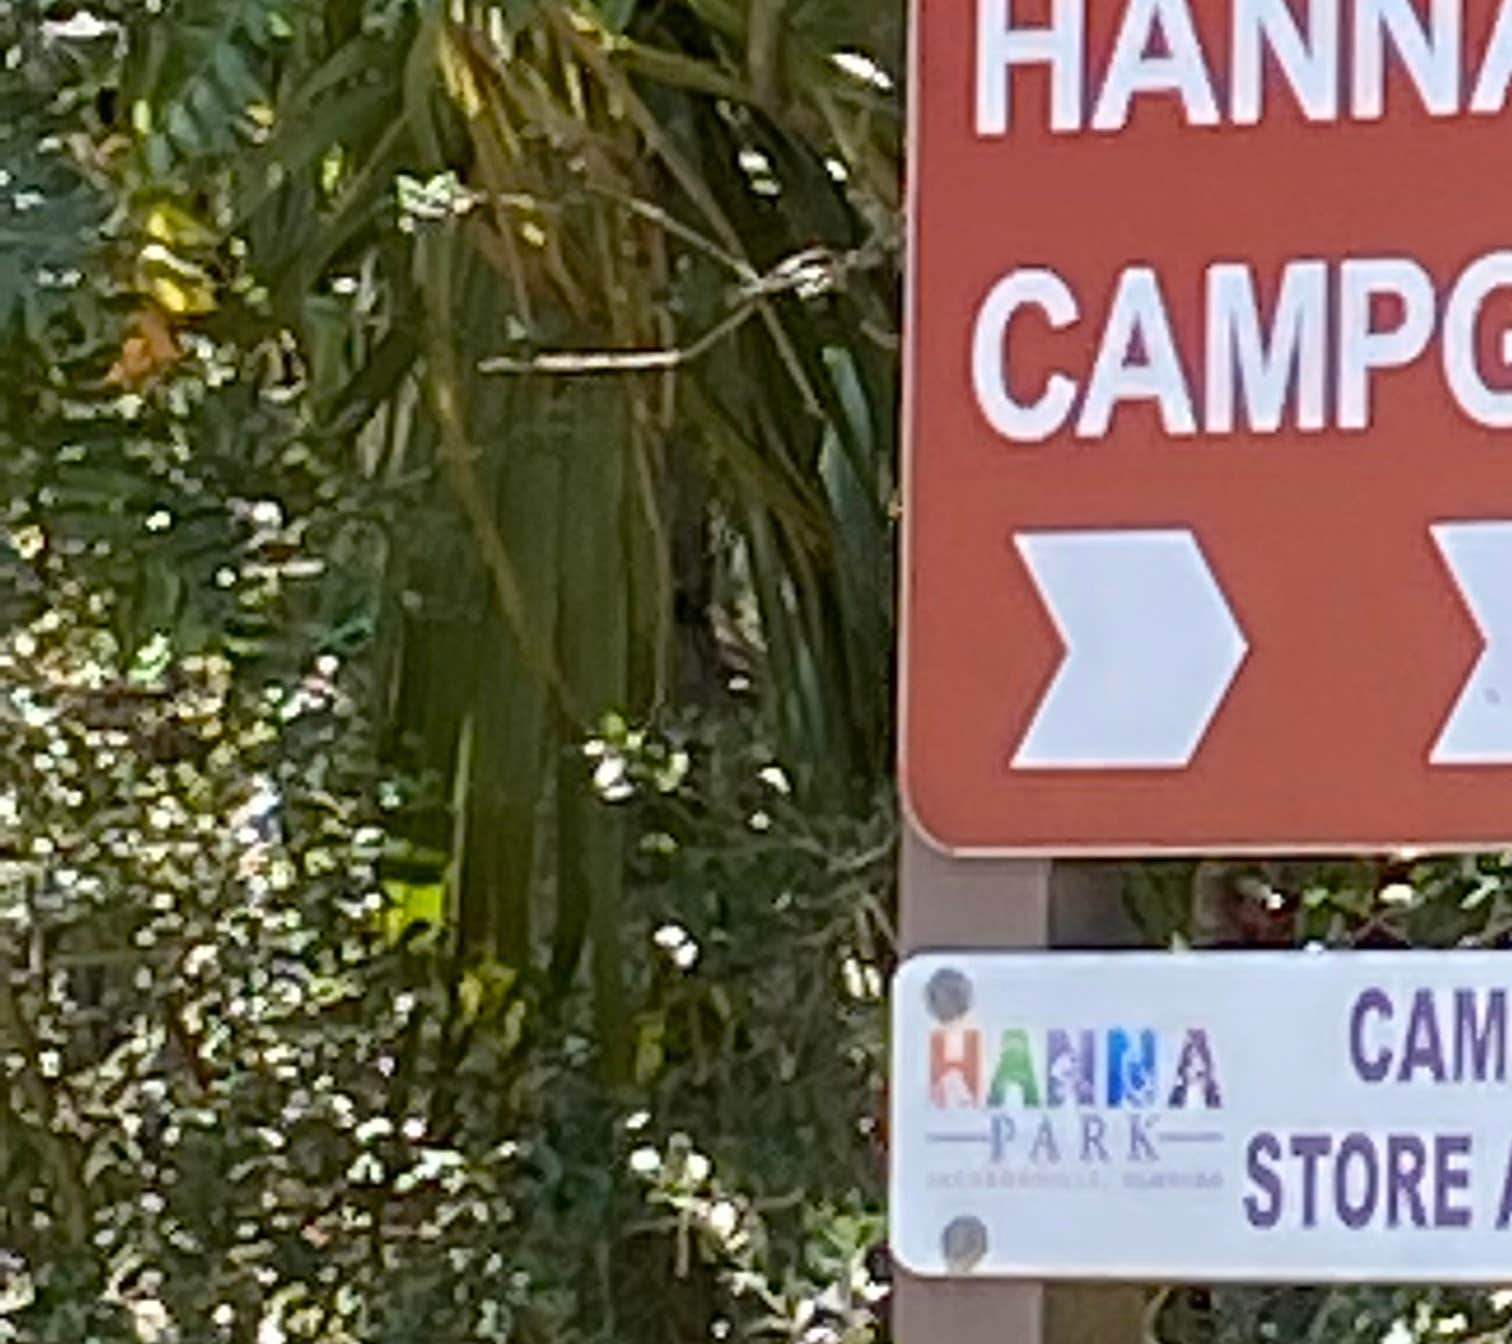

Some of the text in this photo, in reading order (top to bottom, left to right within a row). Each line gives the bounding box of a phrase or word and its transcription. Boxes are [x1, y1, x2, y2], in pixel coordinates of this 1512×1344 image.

[929, 1028, 1222, 1108] HANNA
[989, 1115, 1160, 1162] PARK
[1243, 1132, 1473, 1231] STORE
